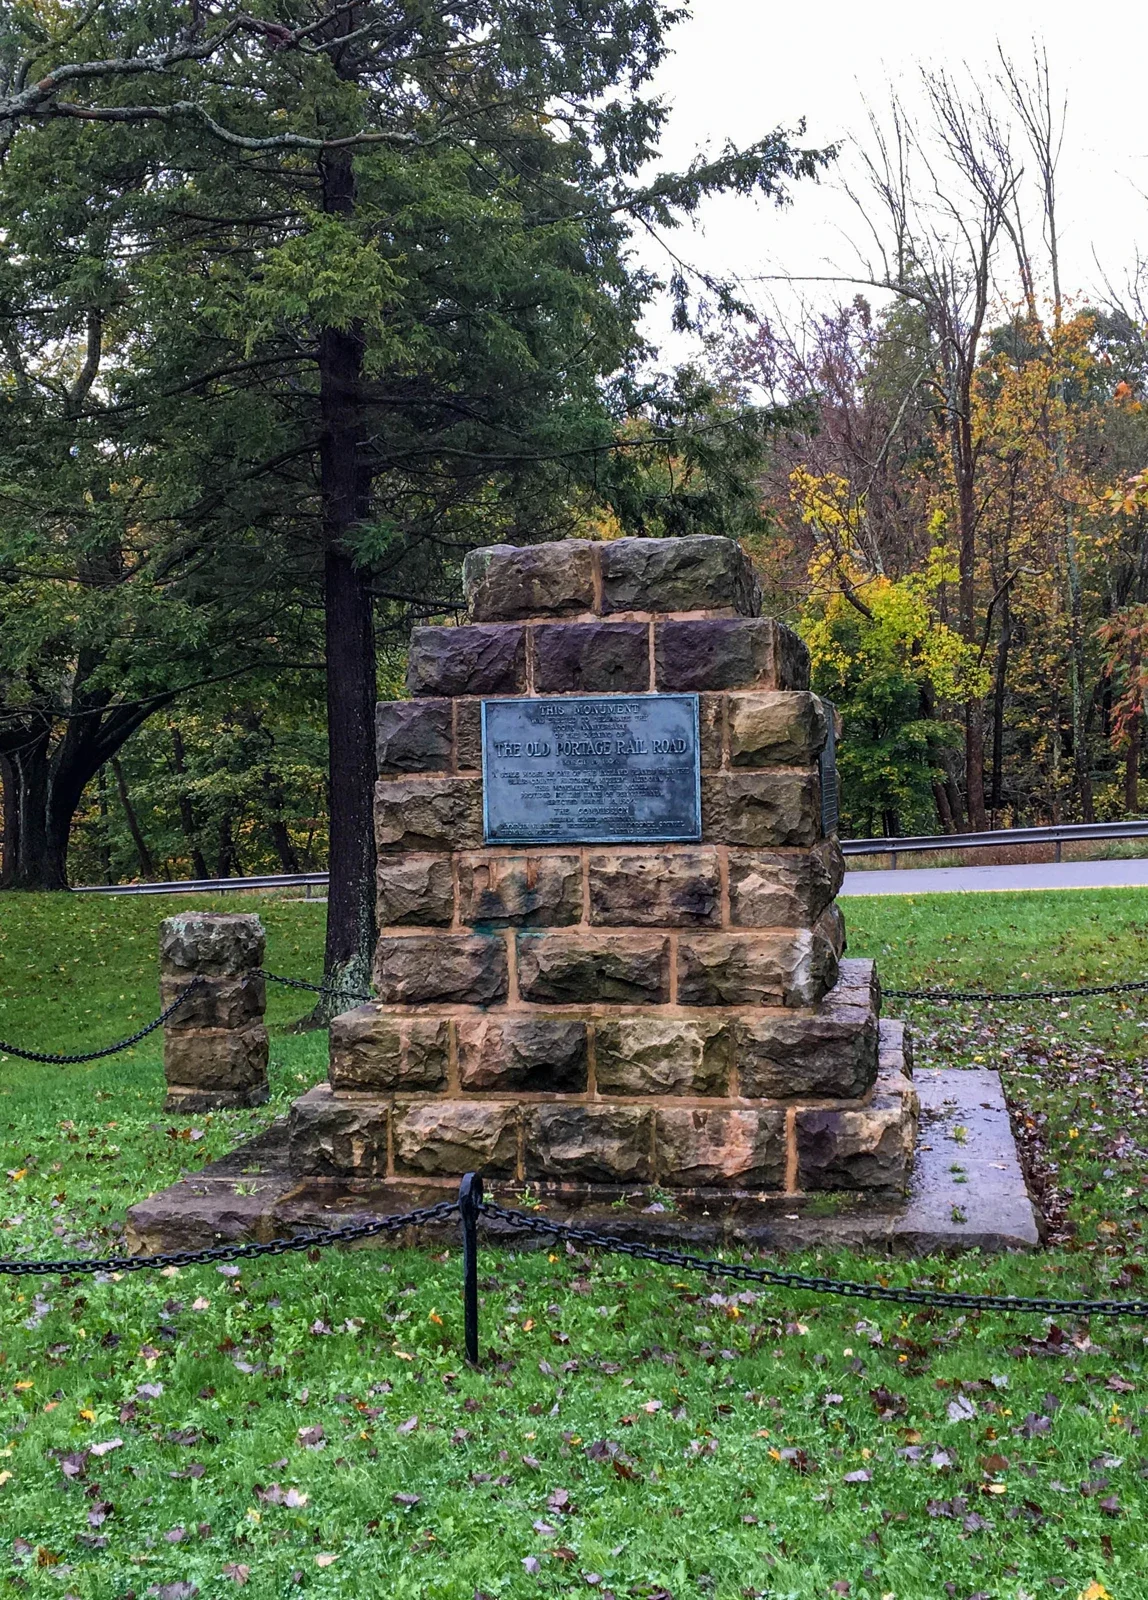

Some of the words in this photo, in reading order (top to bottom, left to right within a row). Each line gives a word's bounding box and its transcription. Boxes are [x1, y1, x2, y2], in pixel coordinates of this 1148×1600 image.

[540, 705, 564, 715] THIS
[575, 704, 639, 715] MONUMENT
[495, 742, 521, 757] THE
[526, 742, 550, 757] OLD
[556, 741, 611, 756] PORTAGE
[617, 739, 647, 755] RAIL
[652, 738, 687, 754] ROAD
[578, 807, 629, 815] COMMISSION
